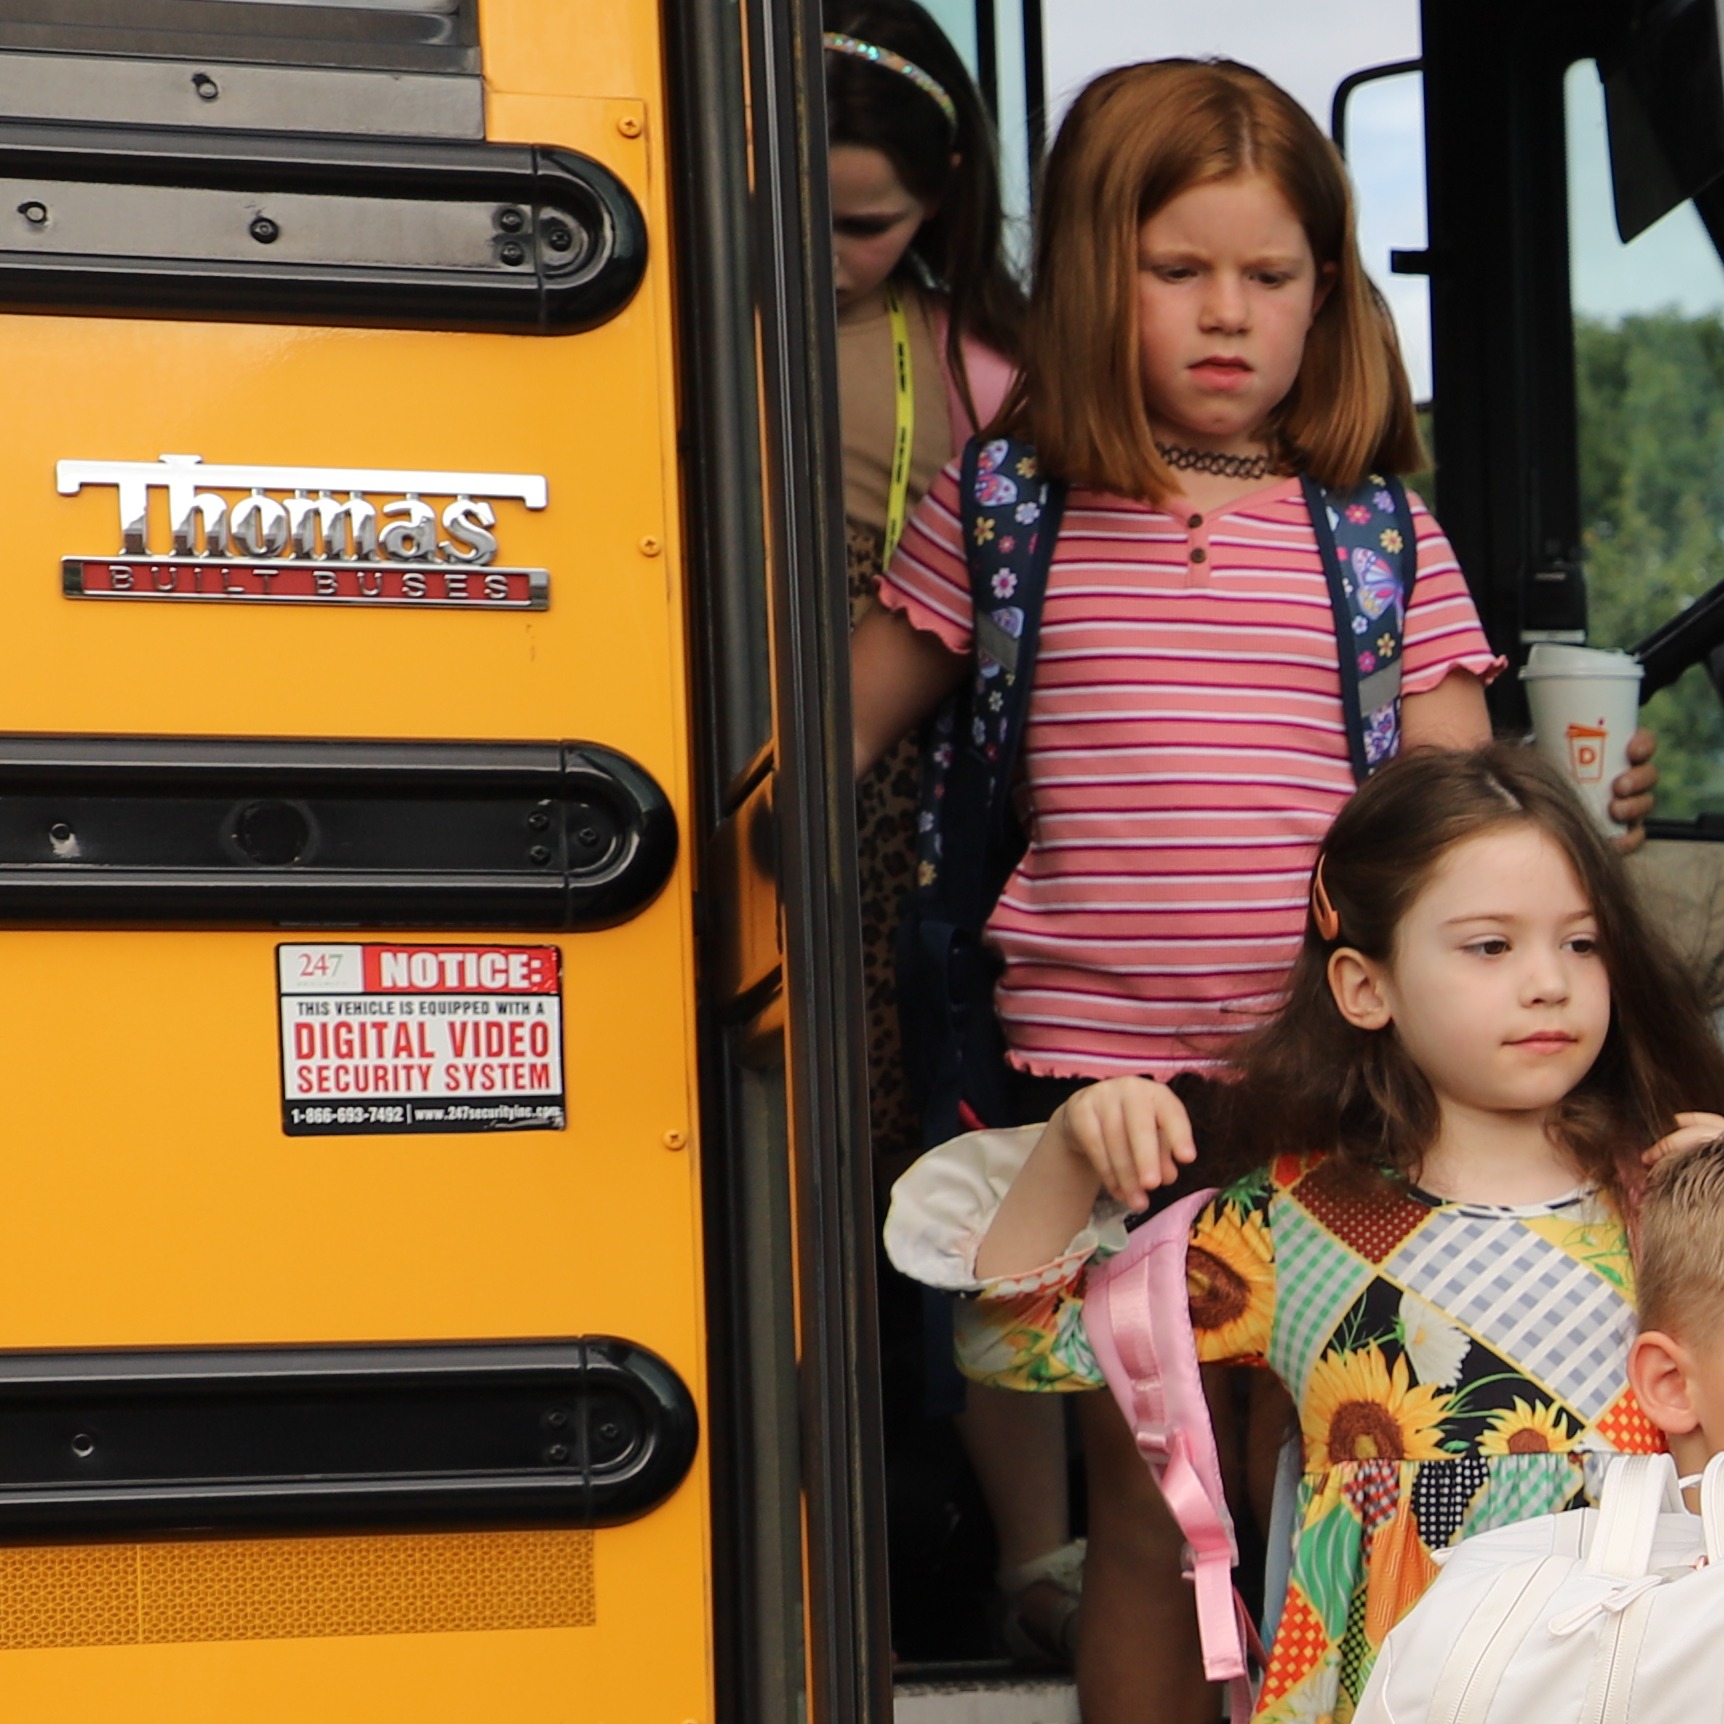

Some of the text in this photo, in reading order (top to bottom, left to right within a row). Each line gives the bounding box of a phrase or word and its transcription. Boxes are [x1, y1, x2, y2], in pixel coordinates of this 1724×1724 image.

[56, 454, 547, 566] Thomas
[108, 565, 508, 599] BUILT BUSES
[1579, 747, 1597, 765] D
[300, 953, 343, 978] 247
[380, 951, 542, 989] NOTICE:
[298, 1001, 544, 1015] THIS VEHICLE IS EQUIPPED WITH A
[293, 1020, 549, 1060] DIGITAL VIDEO
[297, 1063, 550, 1093] SECURITY SYSTEM
